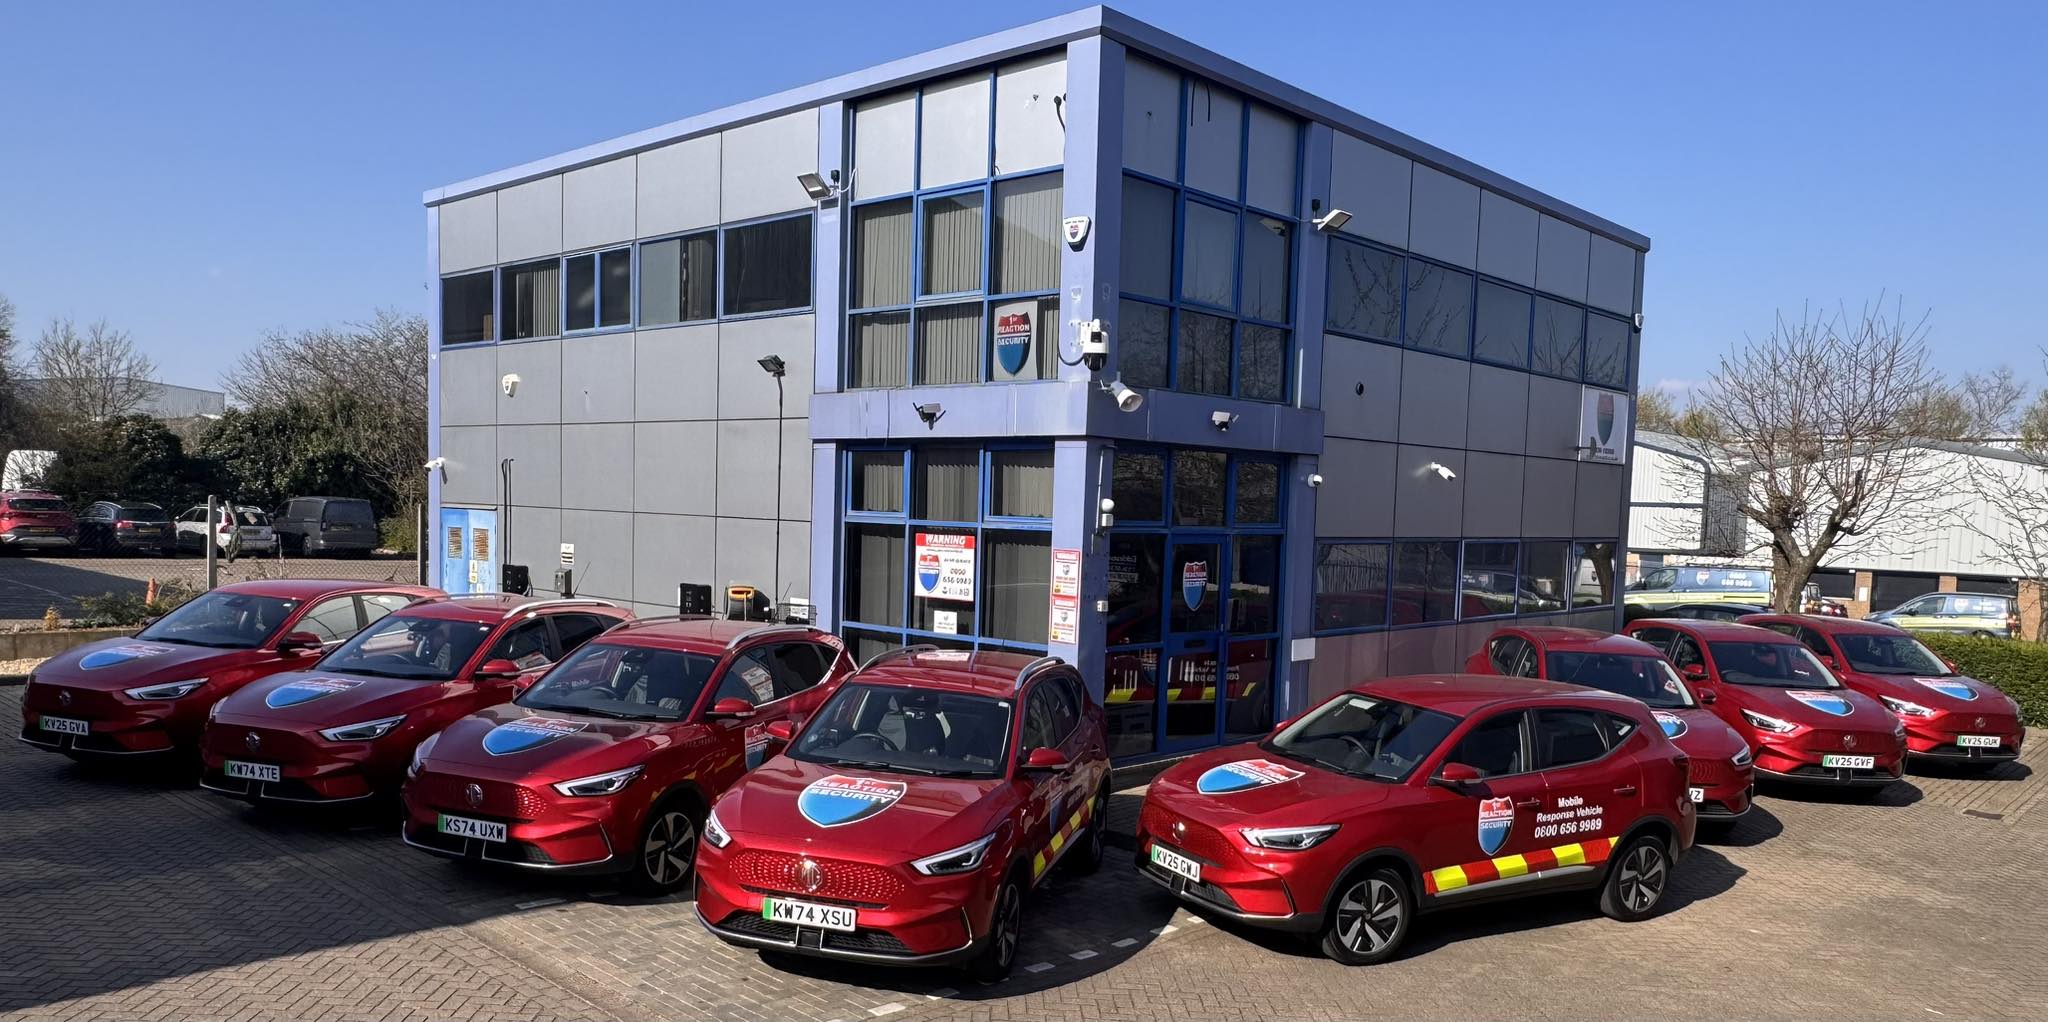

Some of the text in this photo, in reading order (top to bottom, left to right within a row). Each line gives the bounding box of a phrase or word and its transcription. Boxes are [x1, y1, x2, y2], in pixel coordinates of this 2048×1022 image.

[997, 336, 1030, 345] SECURITY
[926, 534, 966, 545] WARNING
[44, 720, 87, 734] KV25 GVA
[1962, 737, 1982, 745] KV25
[1828, 757, 1873, 767] KV25 GVF
[230, 763, 278, 780] KW74 XTE
[817, 780, 901, 795] REACTION
[808, 788, 892, 803] SECURITY
[1557, 796, 1584, 808] Mobile
[1537, 805, 1603, 823] Response Vehicle
[445, 818, 504, 840] KS74 UXW
[1480, 820, 1512, 829] SECURITY
[1534, 818, 1602, 839] 0800 656 9989
[1156, 849, 1199, 878] KV25 GWJ
[773, 901, 853, 927] KW74 XSU
